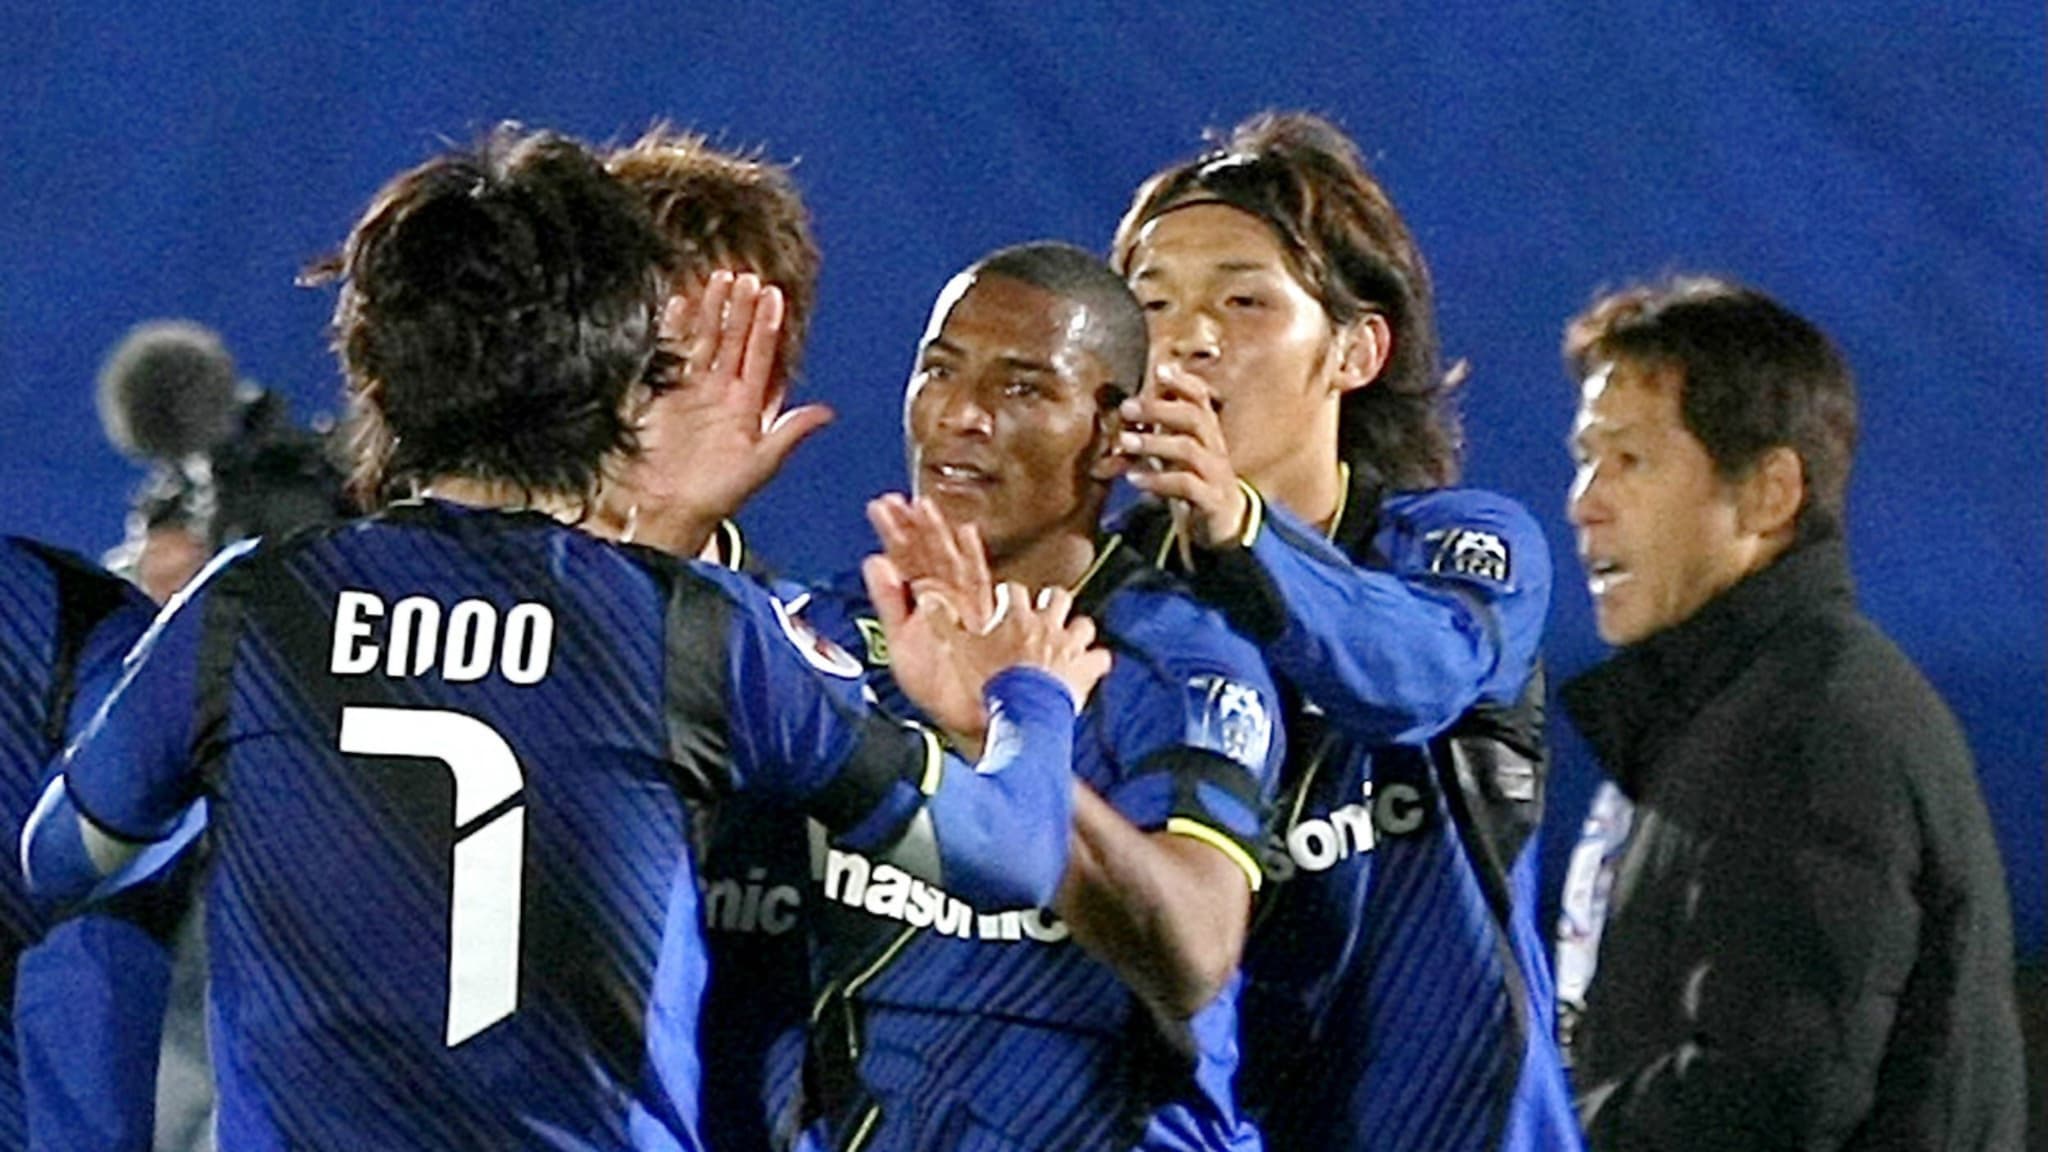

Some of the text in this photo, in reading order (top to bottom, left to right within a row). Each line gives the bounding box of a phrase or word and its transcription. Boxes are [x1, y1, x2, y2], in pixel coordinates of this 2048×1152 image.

[331, 590, 553, 685] ENDO
[338, 705, 526, 1048] 7
[698, 867, 800, 935] nic
